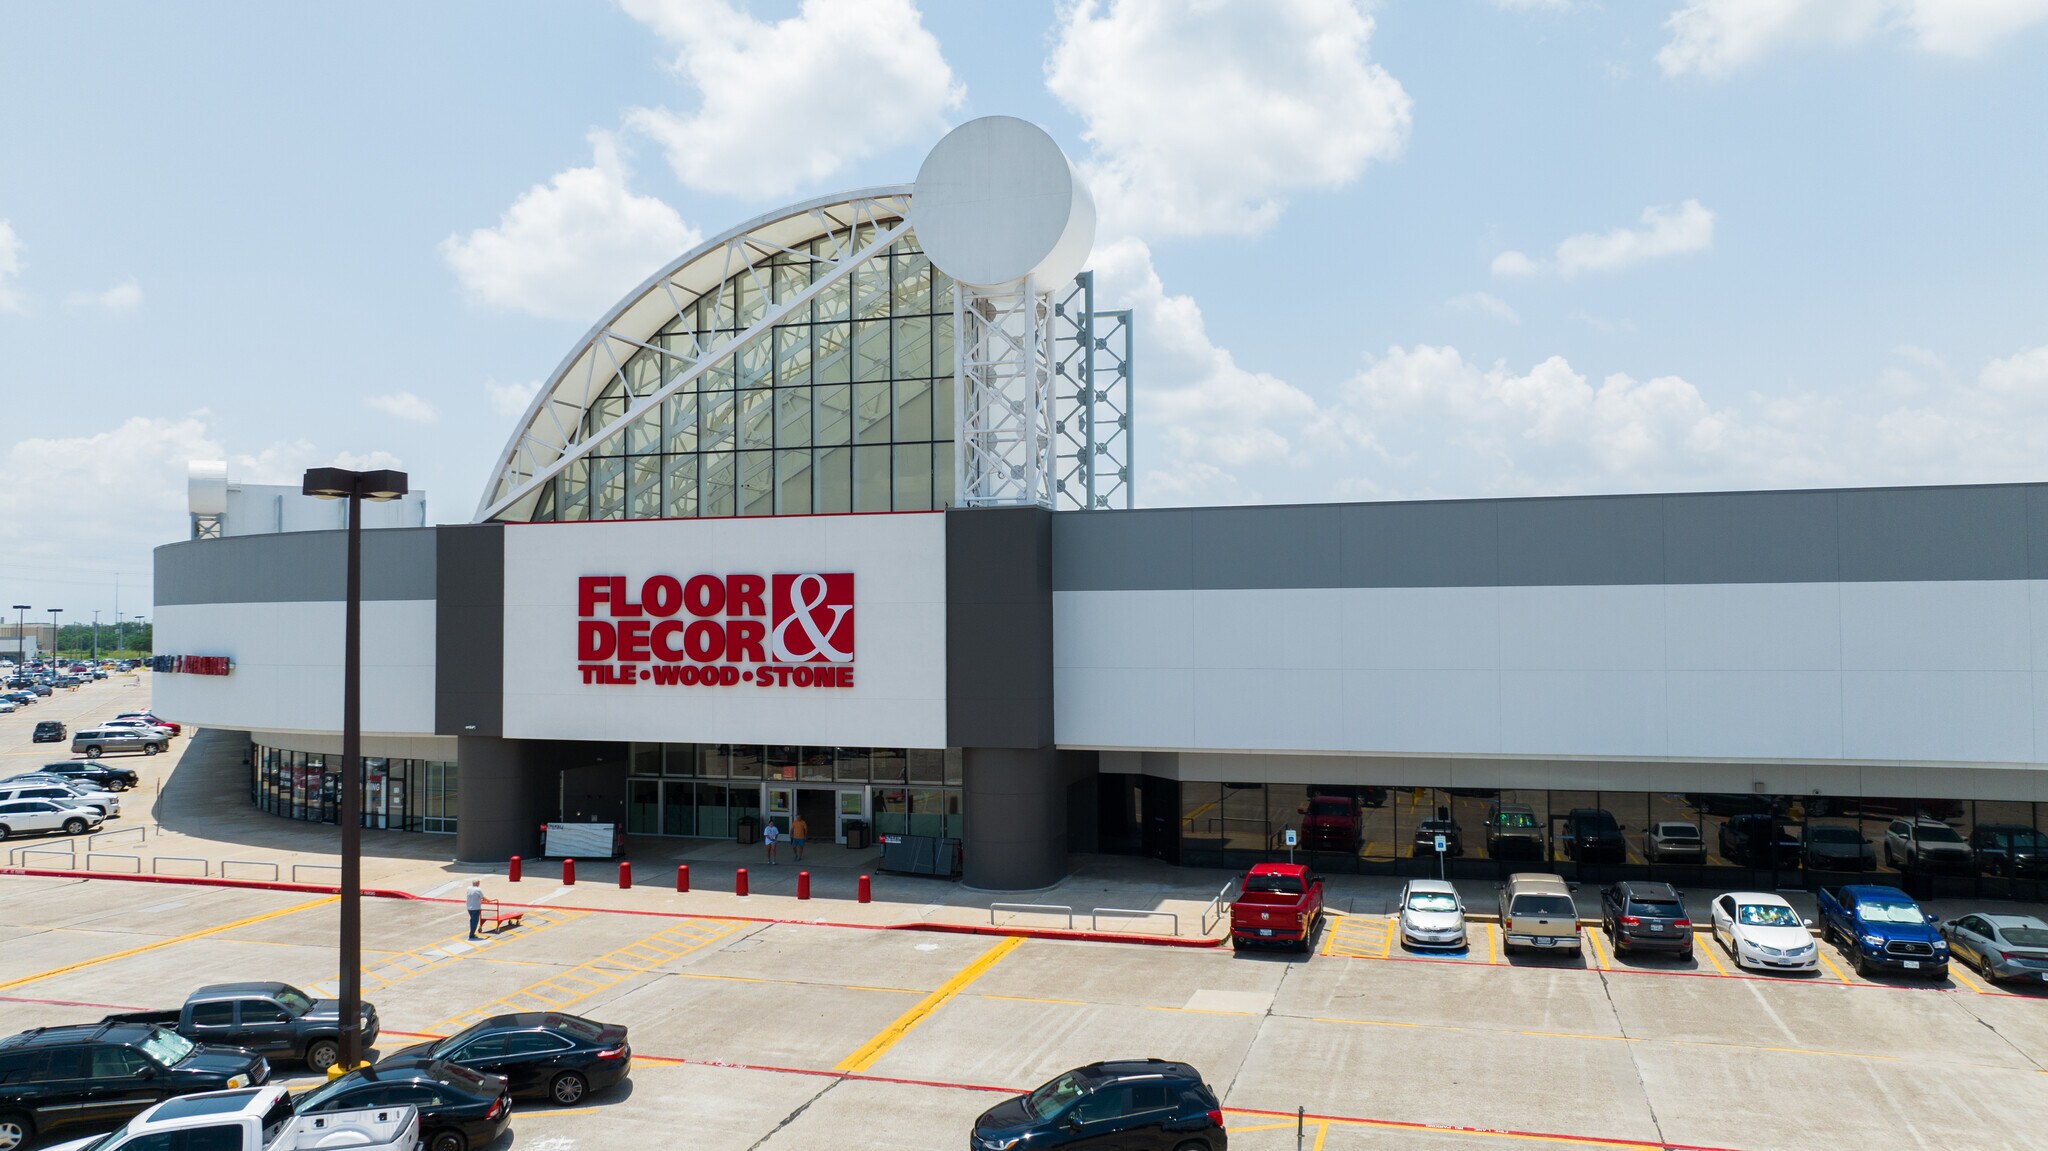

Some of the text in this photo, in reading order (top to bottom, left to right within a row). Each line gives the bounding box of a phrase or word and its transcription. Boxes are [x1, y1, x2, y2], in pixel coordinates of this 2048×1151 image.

[578, 574, 767, 617] FLOOR
[771, 573, 854, 663] &
[578, 619, 767, 663] DECOR
[578, 664, 854, 688] TILE WOOD STONE
